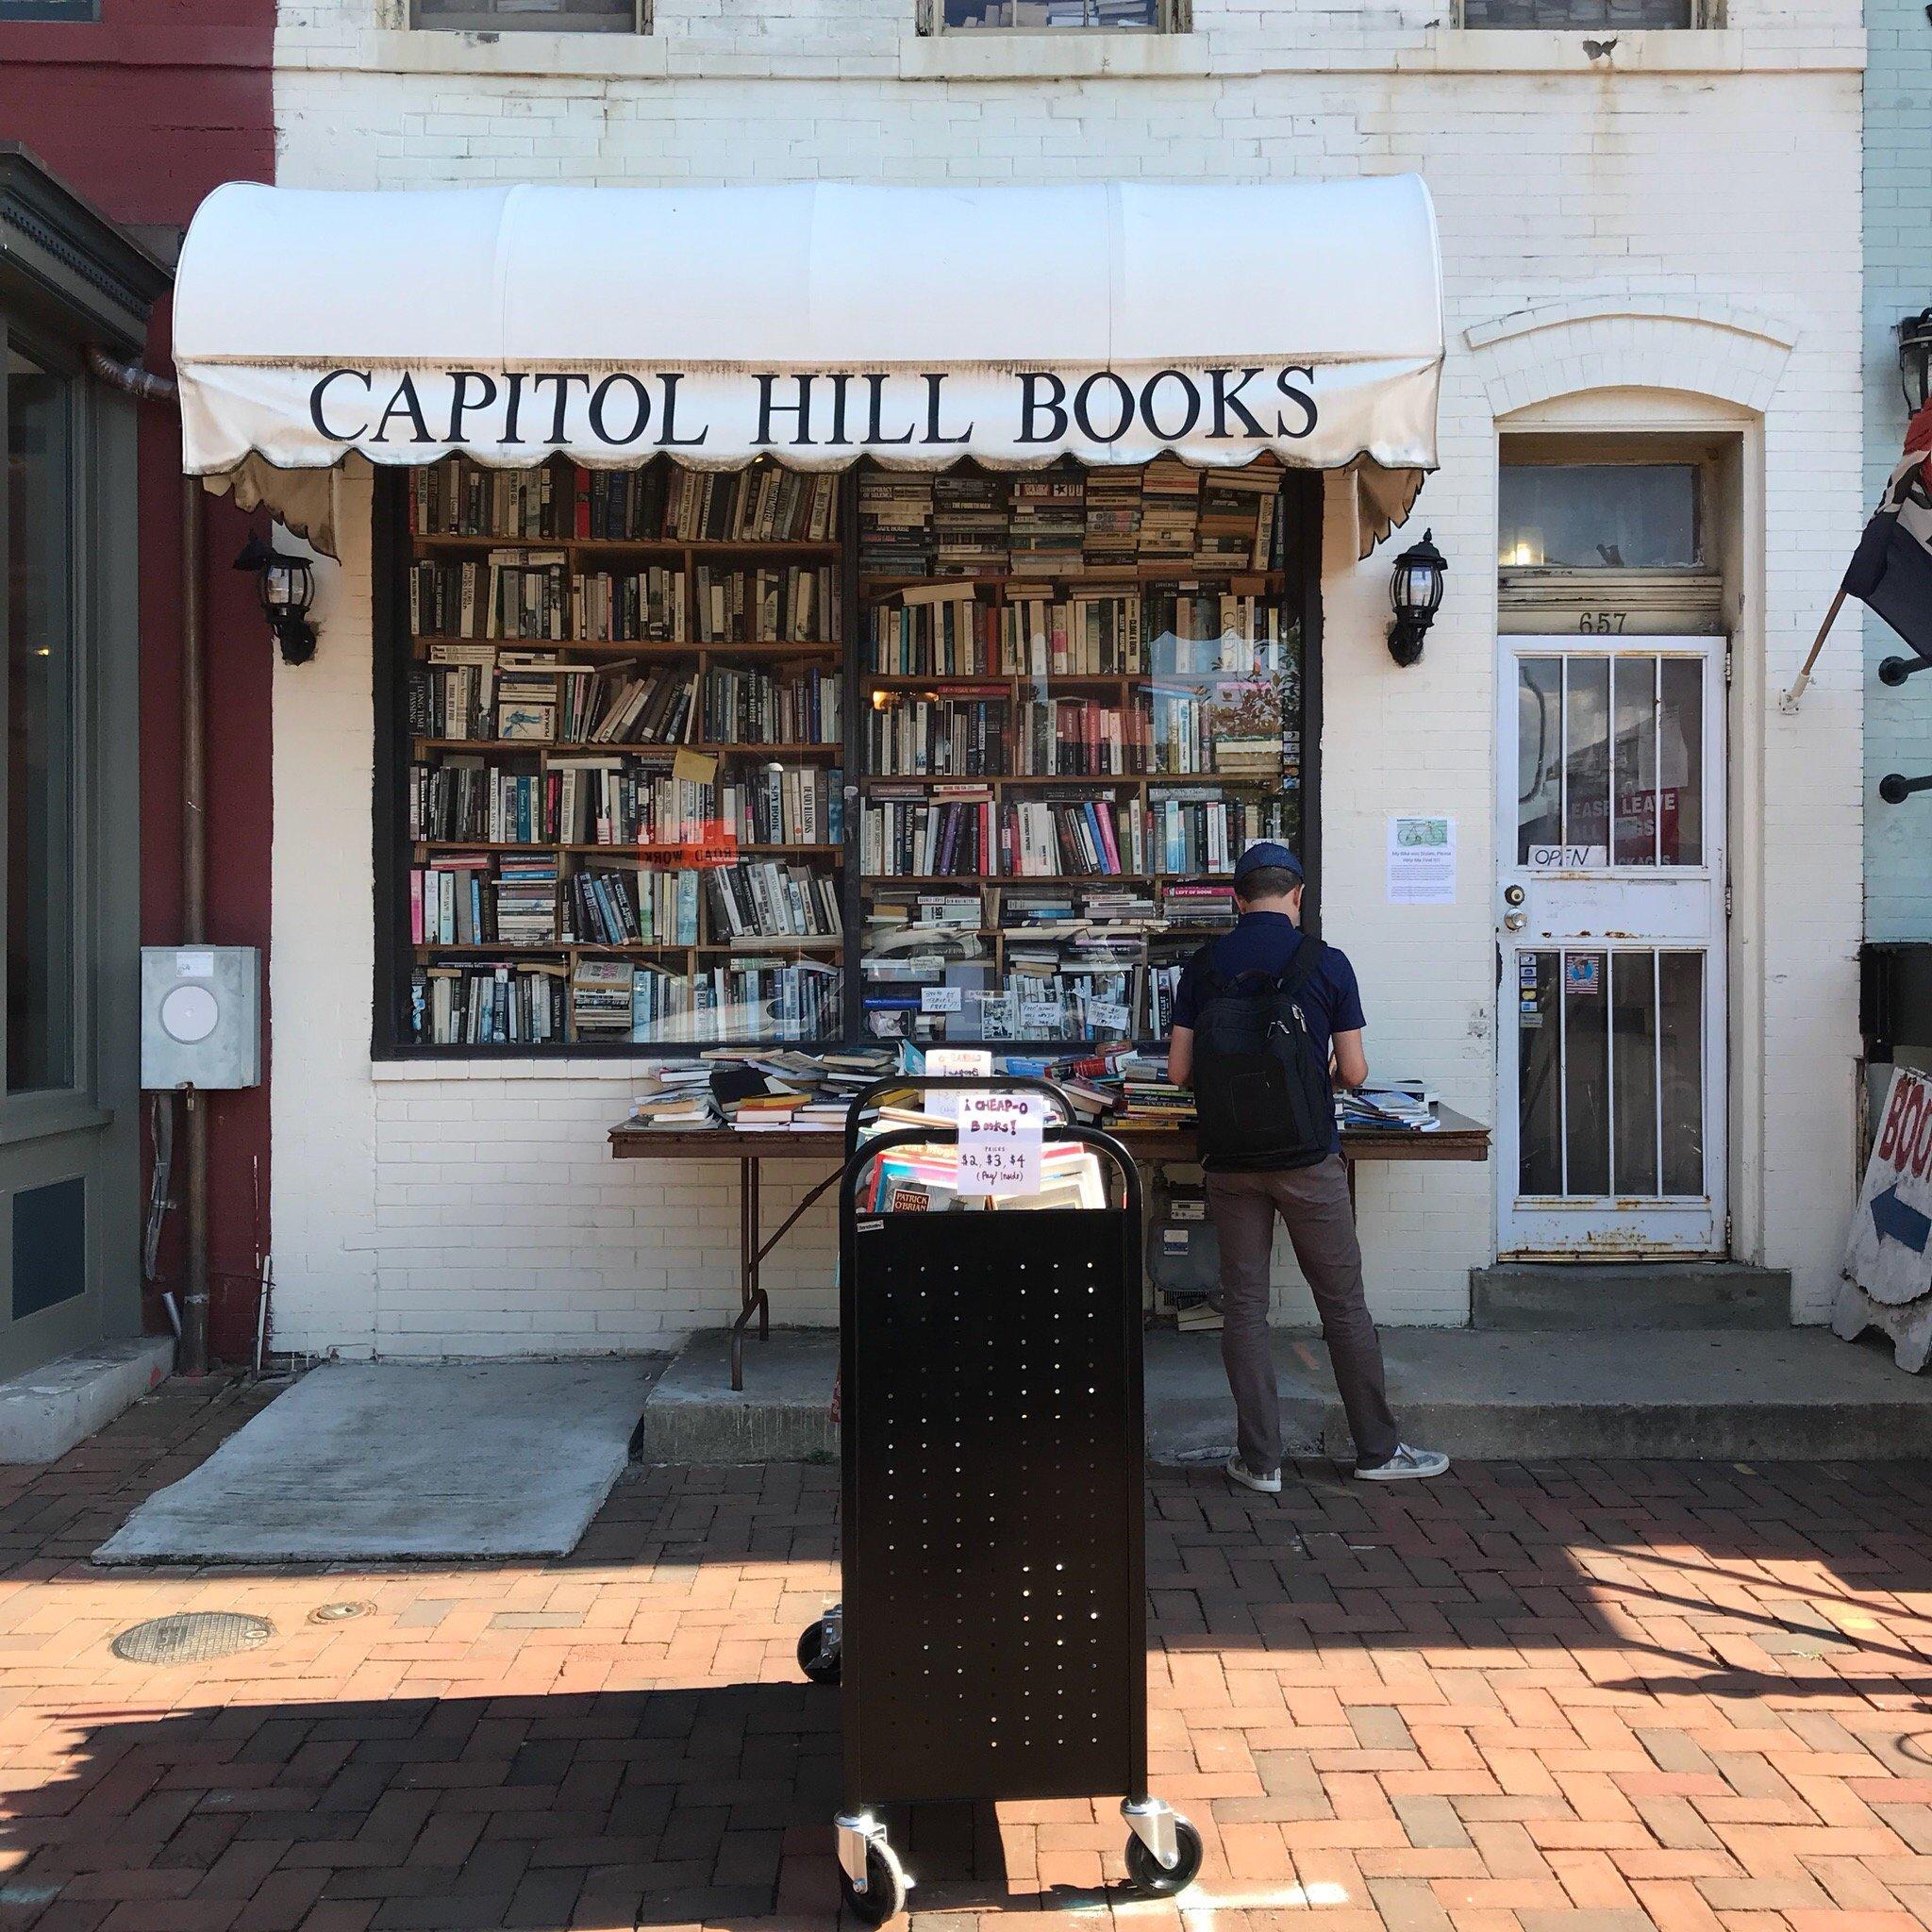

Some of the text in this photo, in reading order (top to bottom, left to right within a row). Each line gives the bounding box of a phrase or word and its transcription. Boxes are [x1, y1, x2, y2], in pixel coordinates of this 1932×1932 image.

[309, 365, 1320, 446] CAPITOL HILL BOOKS
[763, 482, 780, 523] NIGHTMOVER
[1223, 611, 1236, 652] CASEY
[1579, 613, 1627, 634] 657
[771, 785, 779, 831] SPY BOOK
[804, 786, 813, 834] DEADLY ILLUSIONS
[1535, 847, 1590, 866] OPEN
[615, 883, 634, 929] CRUEL APRIL
[697, 992, 706, 1014] BLACK
[975, 1098, 1028, 1115] CHEAP-O
[1878, 1074, 1932, 1183] BOO
[1009, 1154, 1025, 1168] $4
[976, 1172, 997, 1186] (Pay
[894, 1200, 927, 1212] O'BRIAN
[895, 1191, 928, 1206] PATRICK
